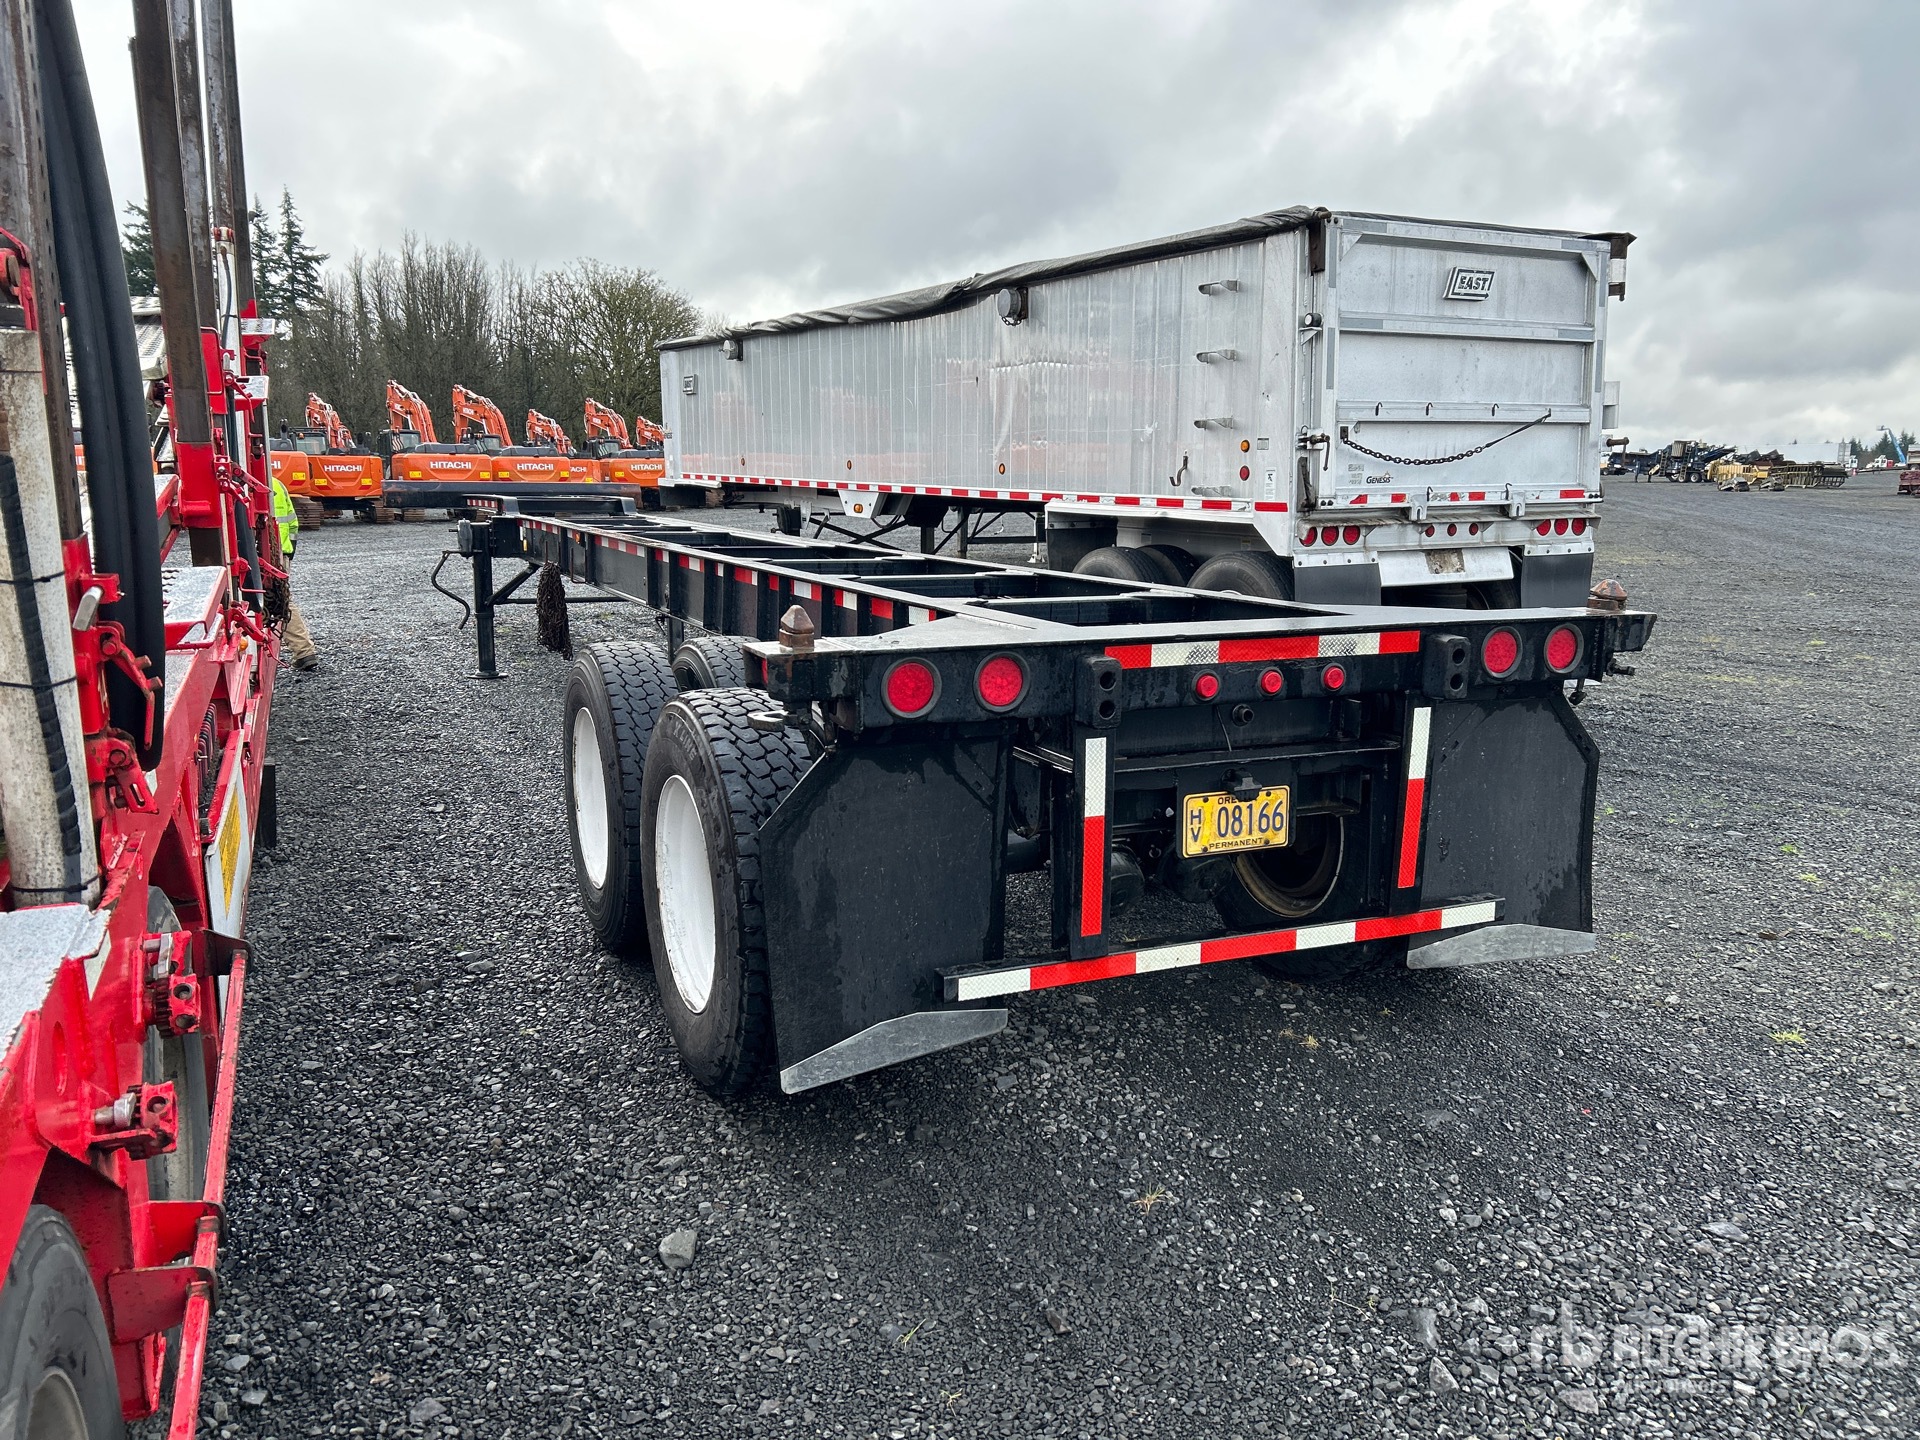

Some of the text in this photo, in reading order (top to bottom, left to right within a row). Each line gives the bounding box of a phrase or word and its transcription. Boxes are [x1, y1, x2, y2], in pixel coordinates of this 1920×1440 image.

[1457, 275, 1489, 291] EAST
[324, 464, 362, 472] HITACHI
[430, 461, 471, 469] HITACHI
[517, 463, 554, 471] HITACHI
[630, 463, 663, 471] HITACHI
[1217, 800, 1284, 838] 08166
[1209, 837, 1264, 850] PERMANENT
